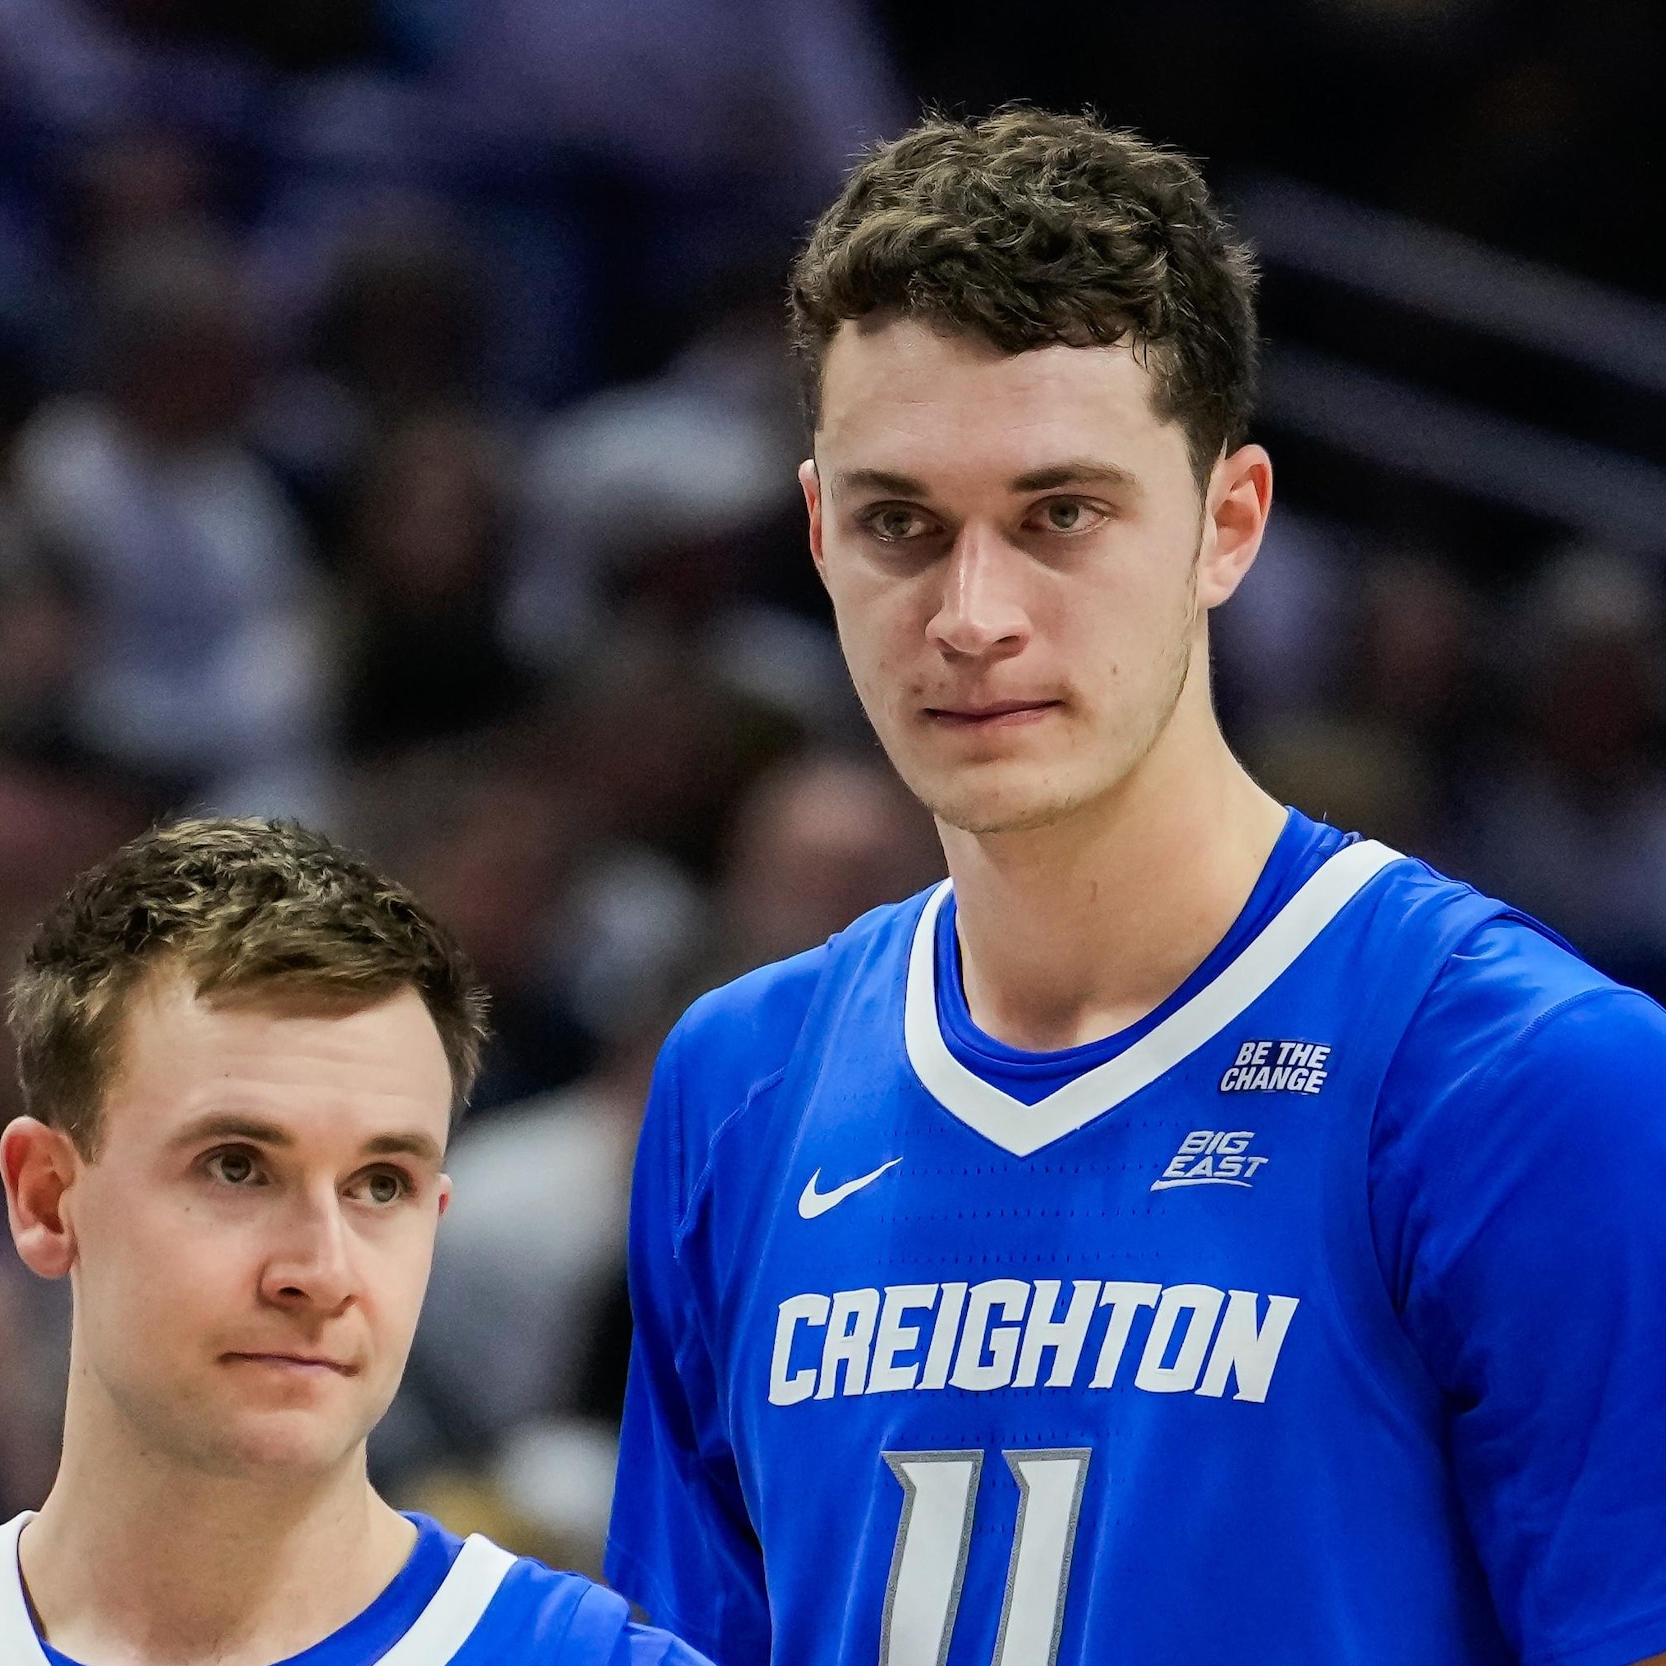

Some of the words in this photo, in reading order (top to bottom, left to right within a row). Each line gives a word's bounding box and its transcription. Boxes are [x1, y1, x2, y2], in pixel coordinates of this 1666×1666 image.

[1234, 1041, 1272, 1067] BE
[1278, 1042, 1331, 1069] THE
[1220, 1066, 1327, 1093] CHANGE
[1178, 1130, 1255, 1155] BIG
[1162, 1155, 1269, 1178] EAST
[768, 1279, 1299, 1405] CREIGHTON
